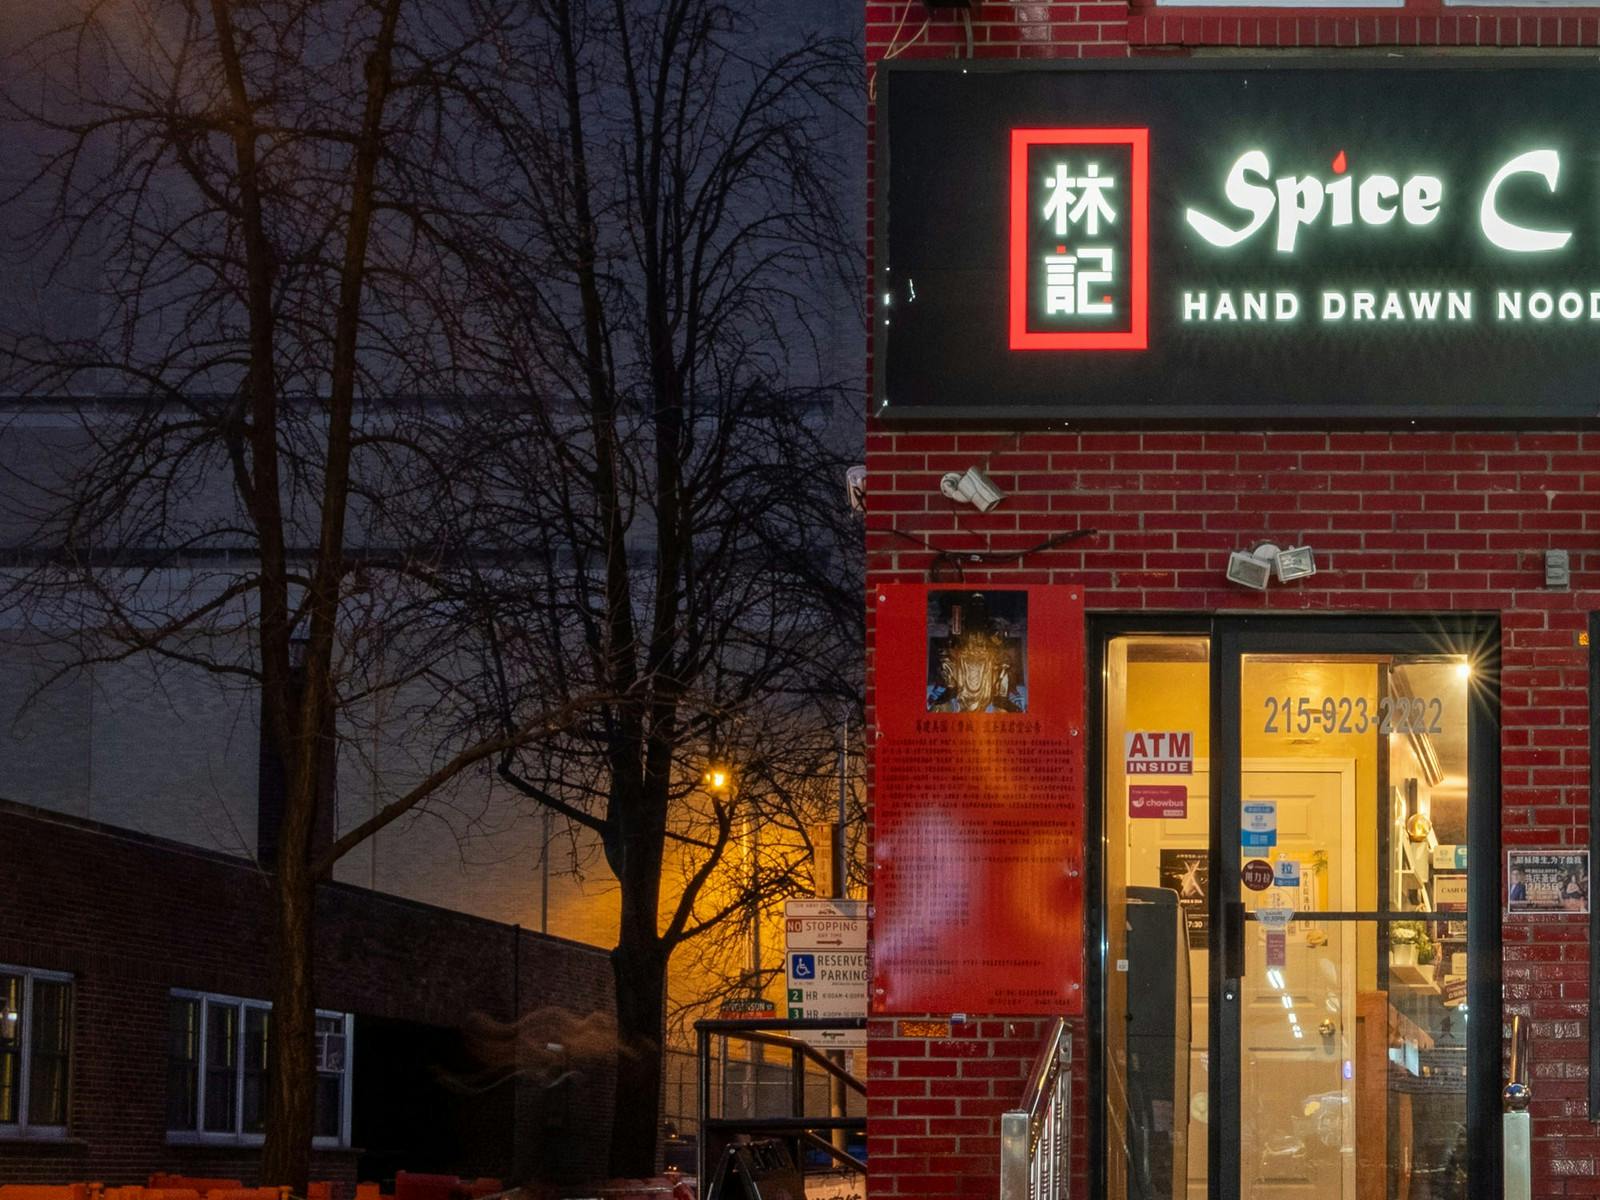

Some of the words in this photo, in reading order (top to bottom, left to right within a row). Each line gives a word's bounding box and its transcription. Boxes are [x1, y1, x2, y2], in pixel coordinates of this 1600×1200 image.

[1186, 150, 1443, 253] Spice
[1481, 150, 1573, 252] C
[1042, 163, 1117, 315] 林記
[1184, 292, 1299, 321] HAND
[1322, 291, 1472, 320] DRAWN
[1264, 697, 1443, 734] 215-923-2222
[1129, 733, 1190, 757] ATM
[1129, 762, 1189, 772] INSIDE
[1146, 799, 1184, 807] chowbus
[787, 921, 801, 932] NO
[806, 922, 858, 931] STOPPING
[806, 991, 818, 1000] HR
